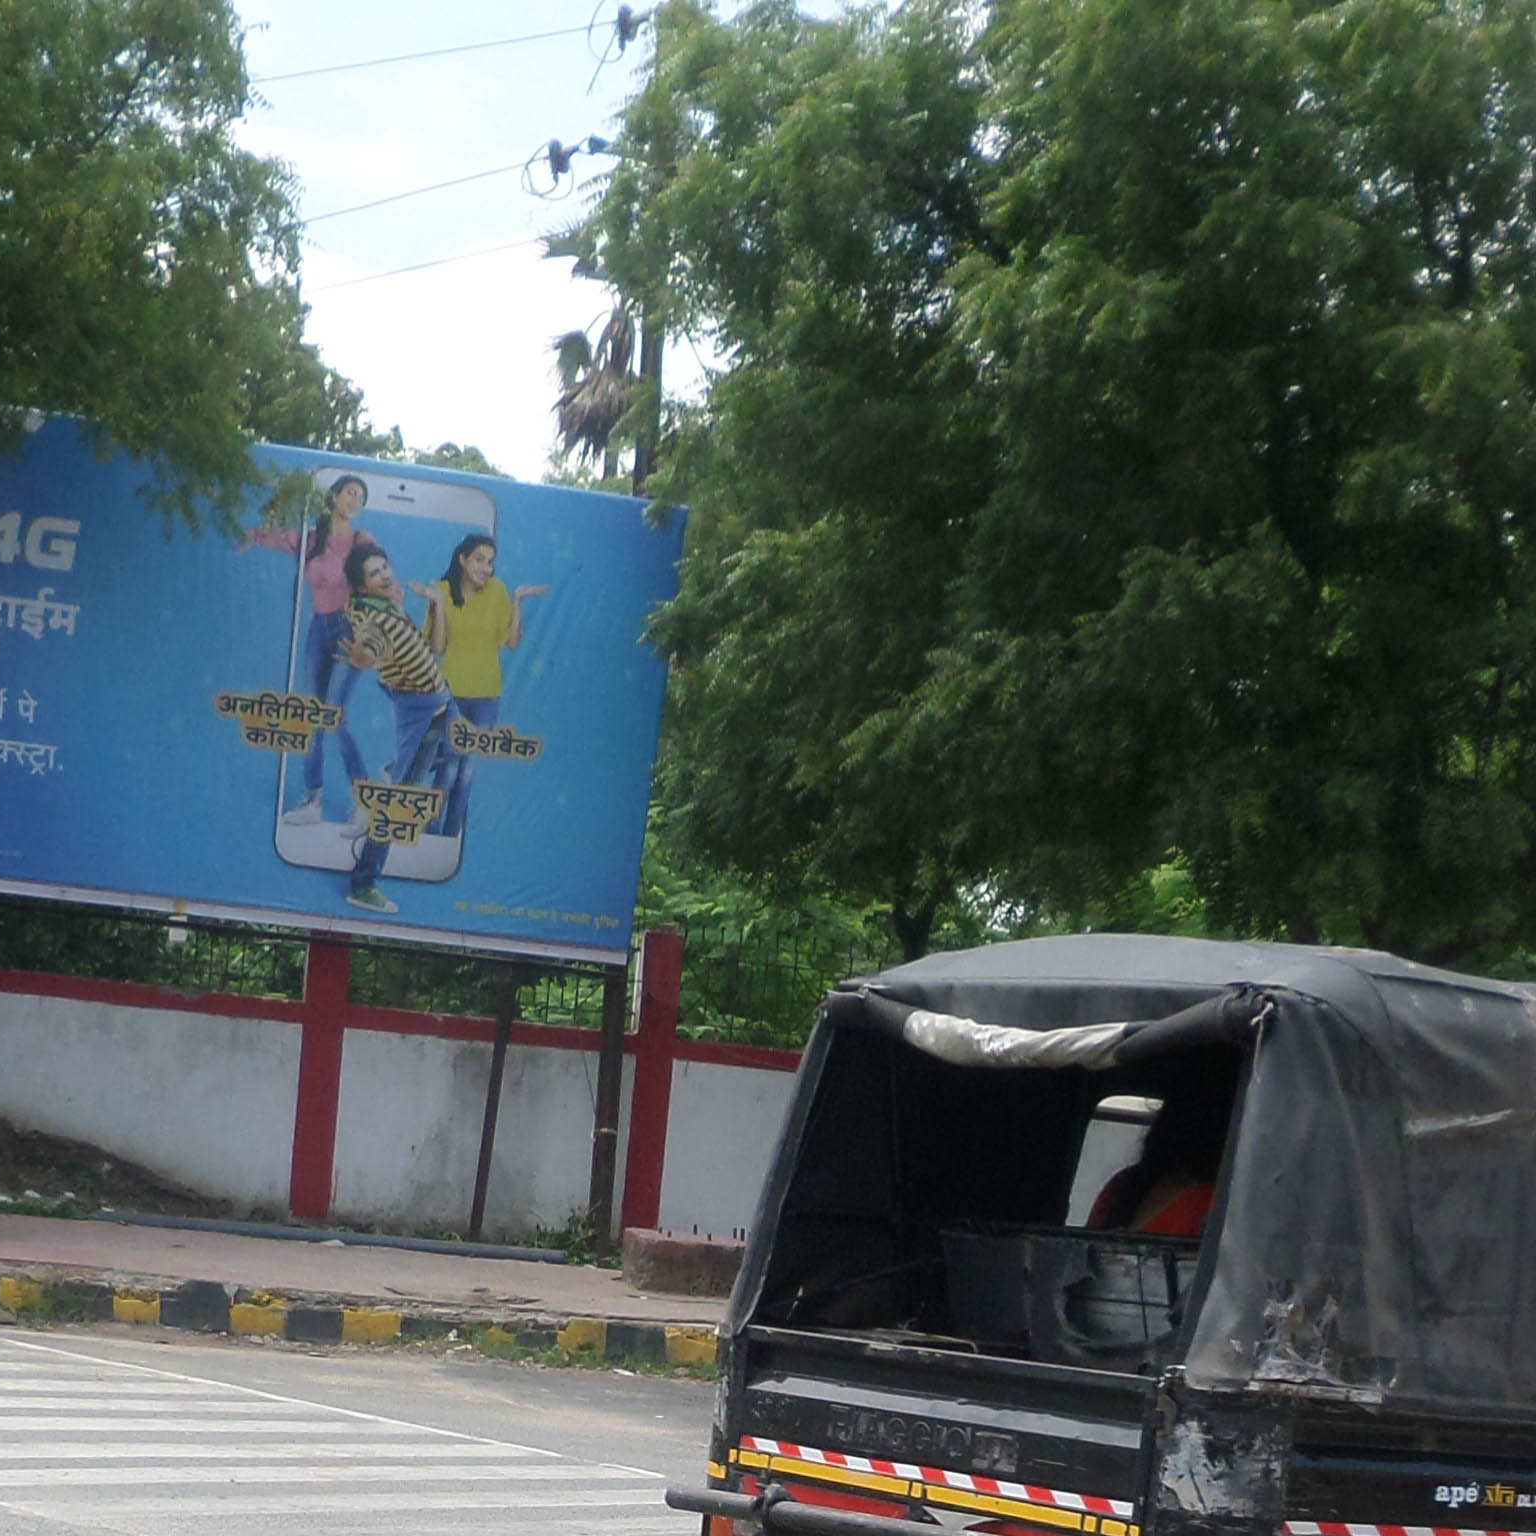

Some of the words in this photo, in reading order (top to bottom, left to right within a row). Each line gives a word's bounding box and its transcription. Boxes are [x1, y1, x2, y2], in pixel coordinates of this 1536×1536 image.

[16, 688, 39, 724] पे
[217, 692, 340, 727] अनलिमिटेड
[244, 719, 310, 751] कॉल्स
[451, 722, 540, 759] कैशबैक
[357, 783, 441, 820] एक्स्ट्रा
[371, 809, 420, 844] डेटा
